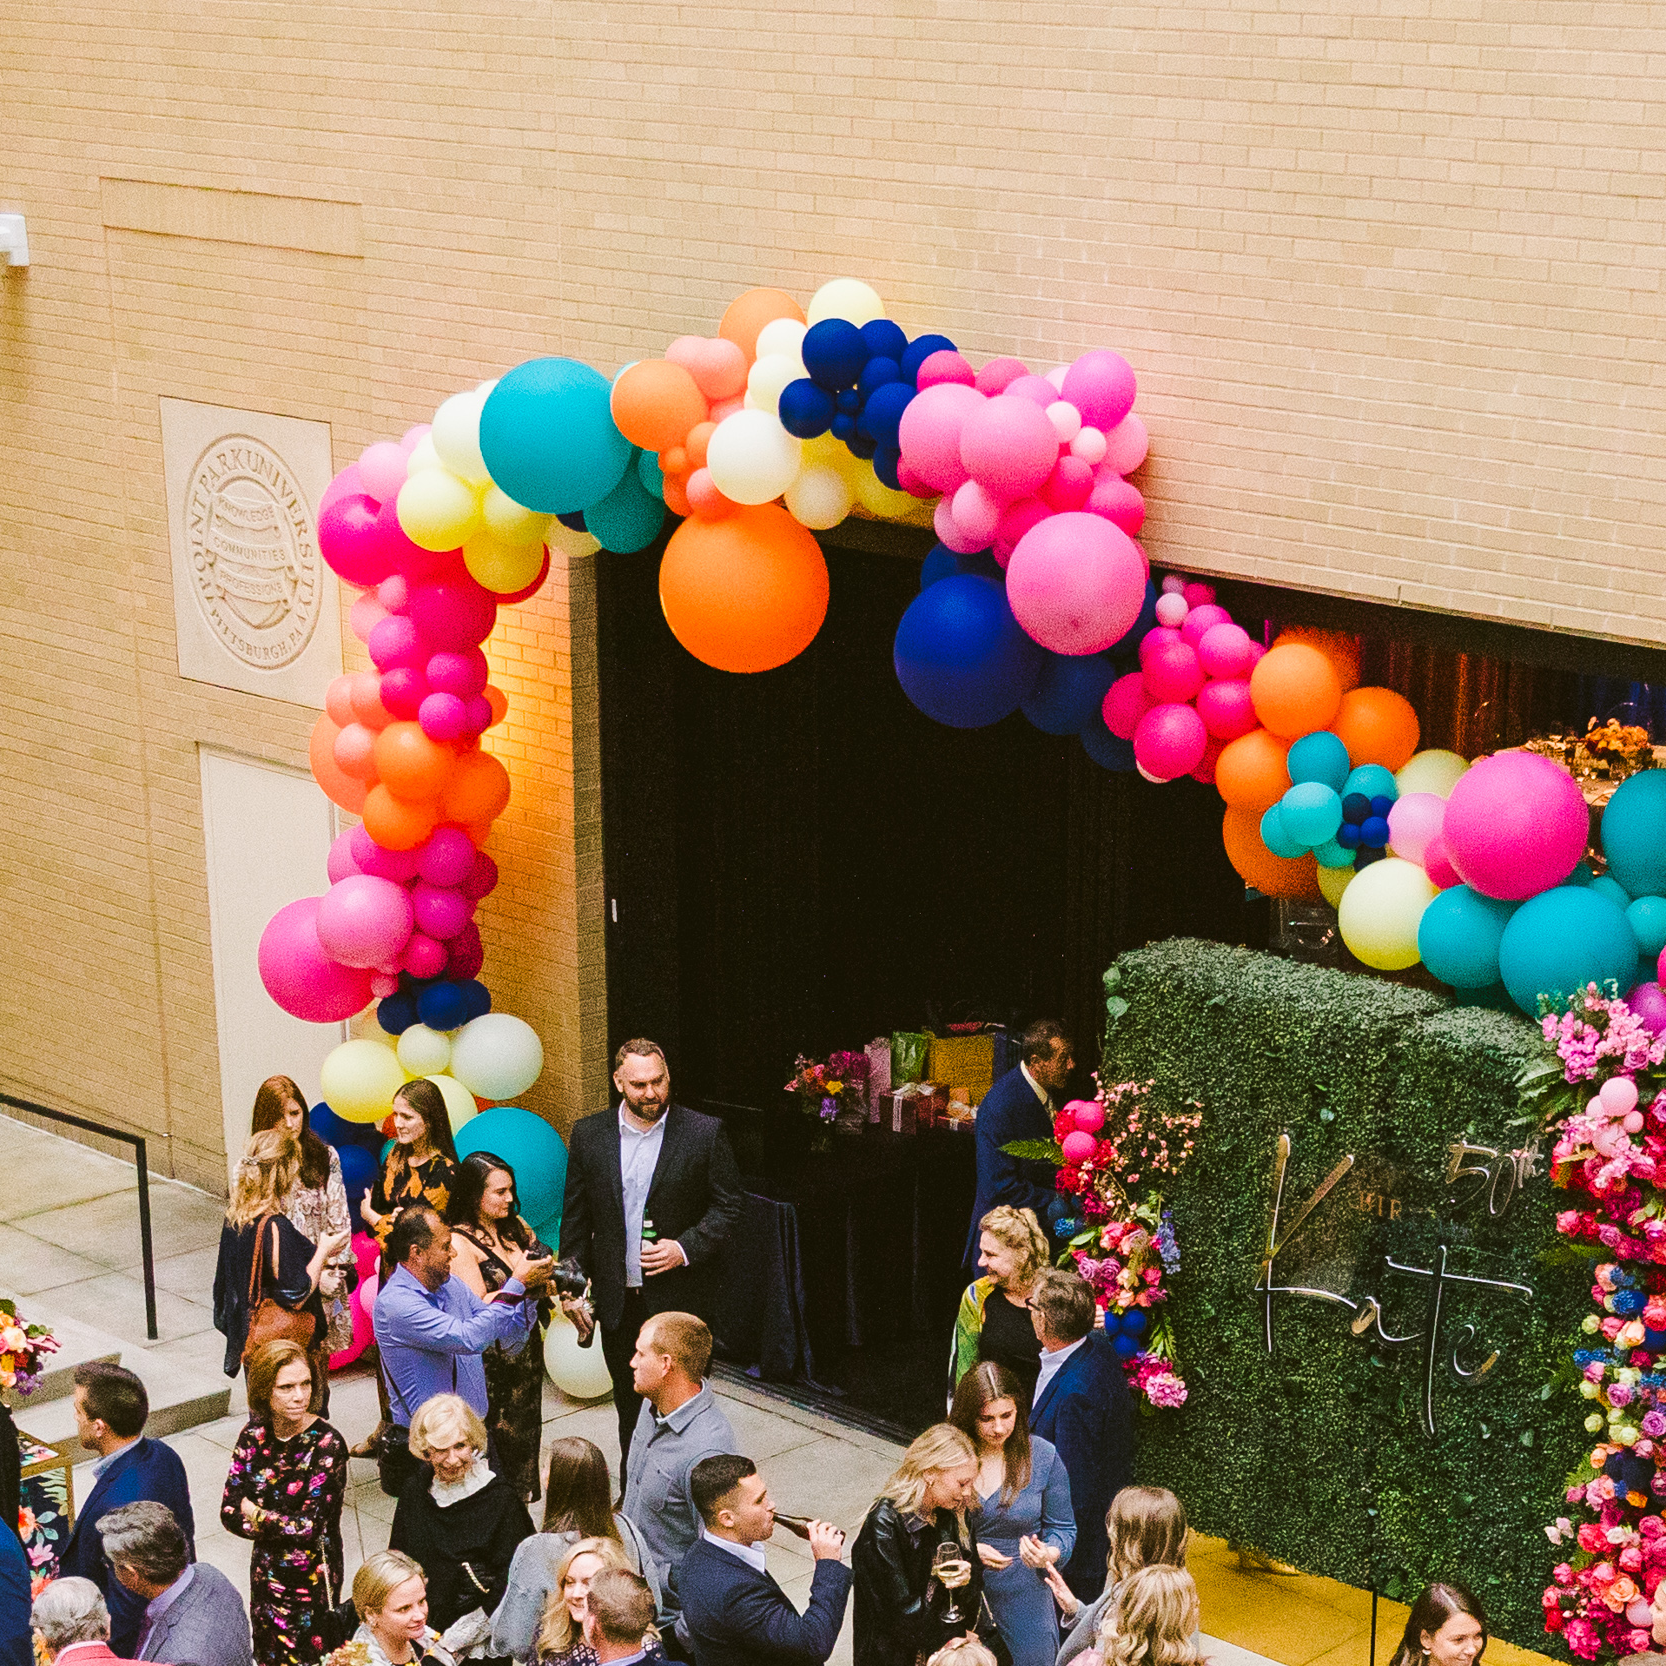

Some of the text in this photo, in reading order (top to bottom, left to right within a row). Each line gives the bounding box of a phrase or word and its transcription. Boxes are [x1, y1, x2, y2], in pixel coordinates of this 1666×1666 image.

[218, 499, 274, 523] KNOWLEDGE
[190, 449, 315, 616] POINT PARK UNIVERSITY
[213, 535, 285, 562] COMMUNITIES
[219, 570, 283, 596] PROFESSIONS
[288, 626, 304, 647] PA
